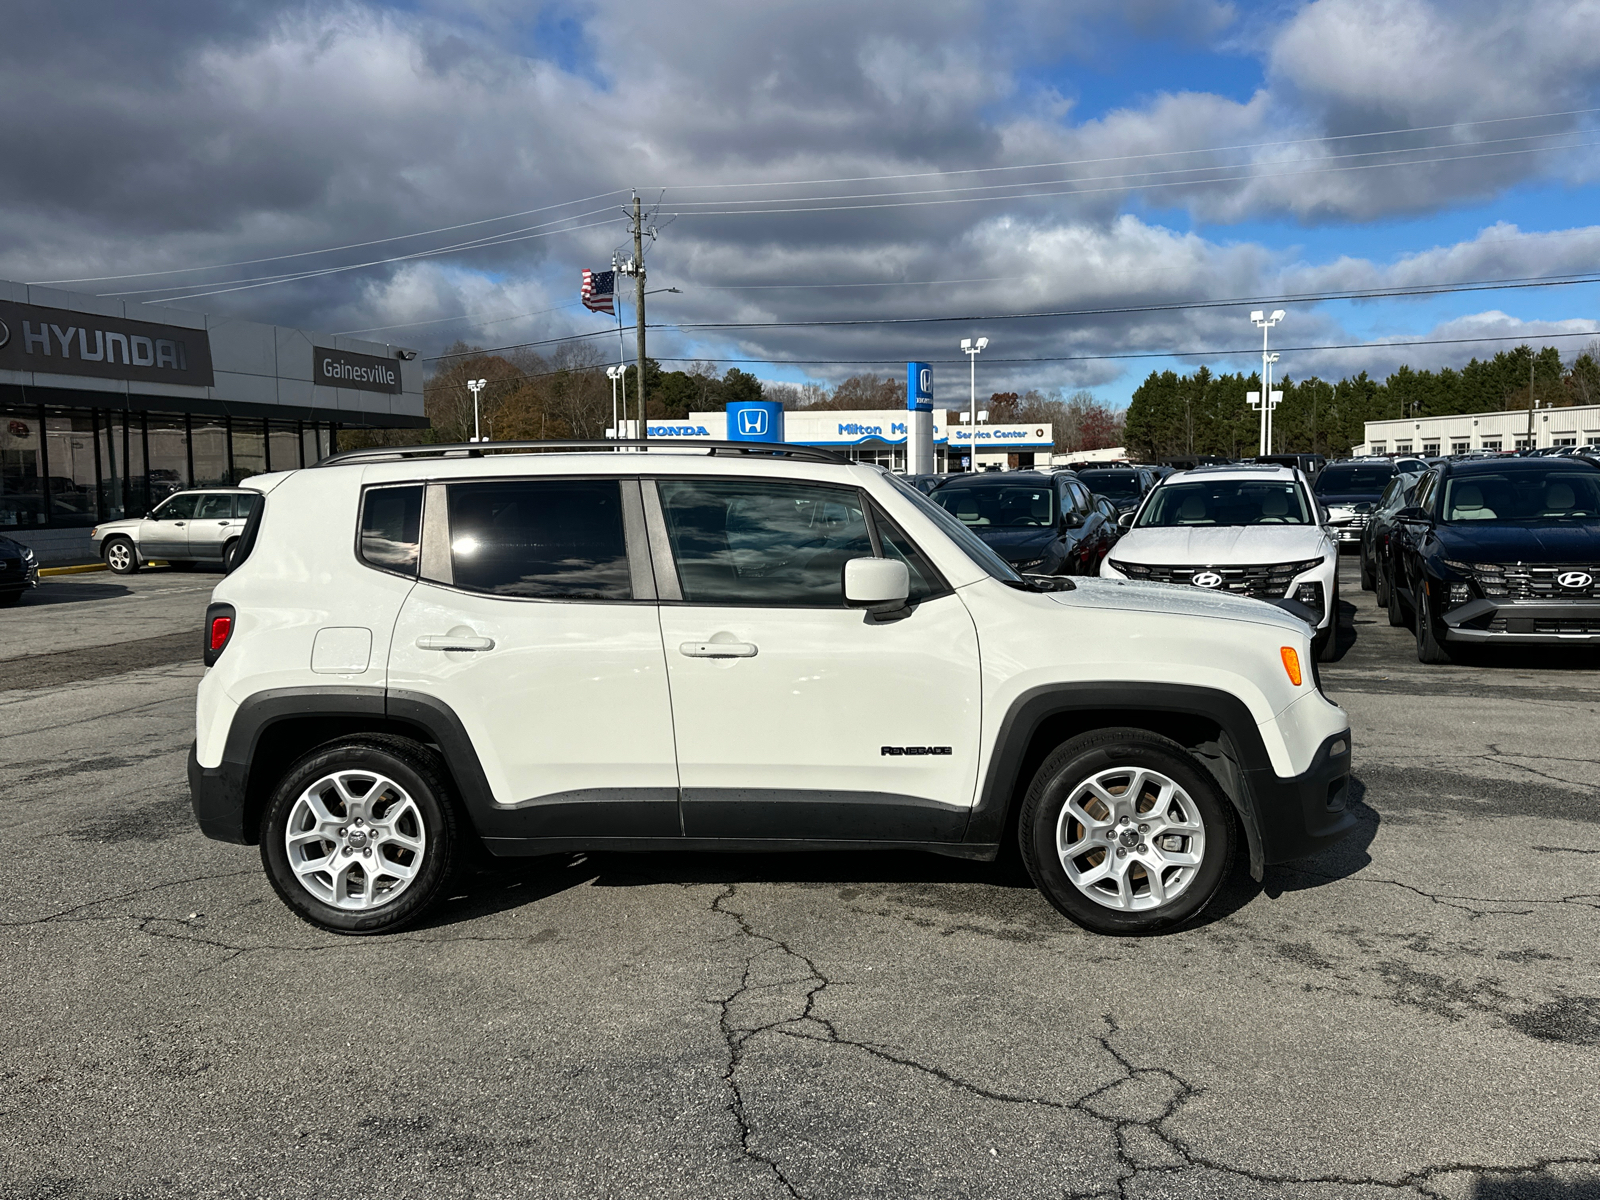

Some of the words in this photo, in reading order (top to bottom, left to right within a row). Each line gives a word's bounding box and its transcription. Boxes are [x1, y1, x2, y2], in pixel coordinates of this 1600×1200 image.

[22, 320, 187, 371] HYUNDAI
[323, 358, 395, 385] Gainesville
[838, 423, 882, 435] Milton
[993, 430, 1028, 439] Center
[881, 746, 952, 756] RENEGADE
